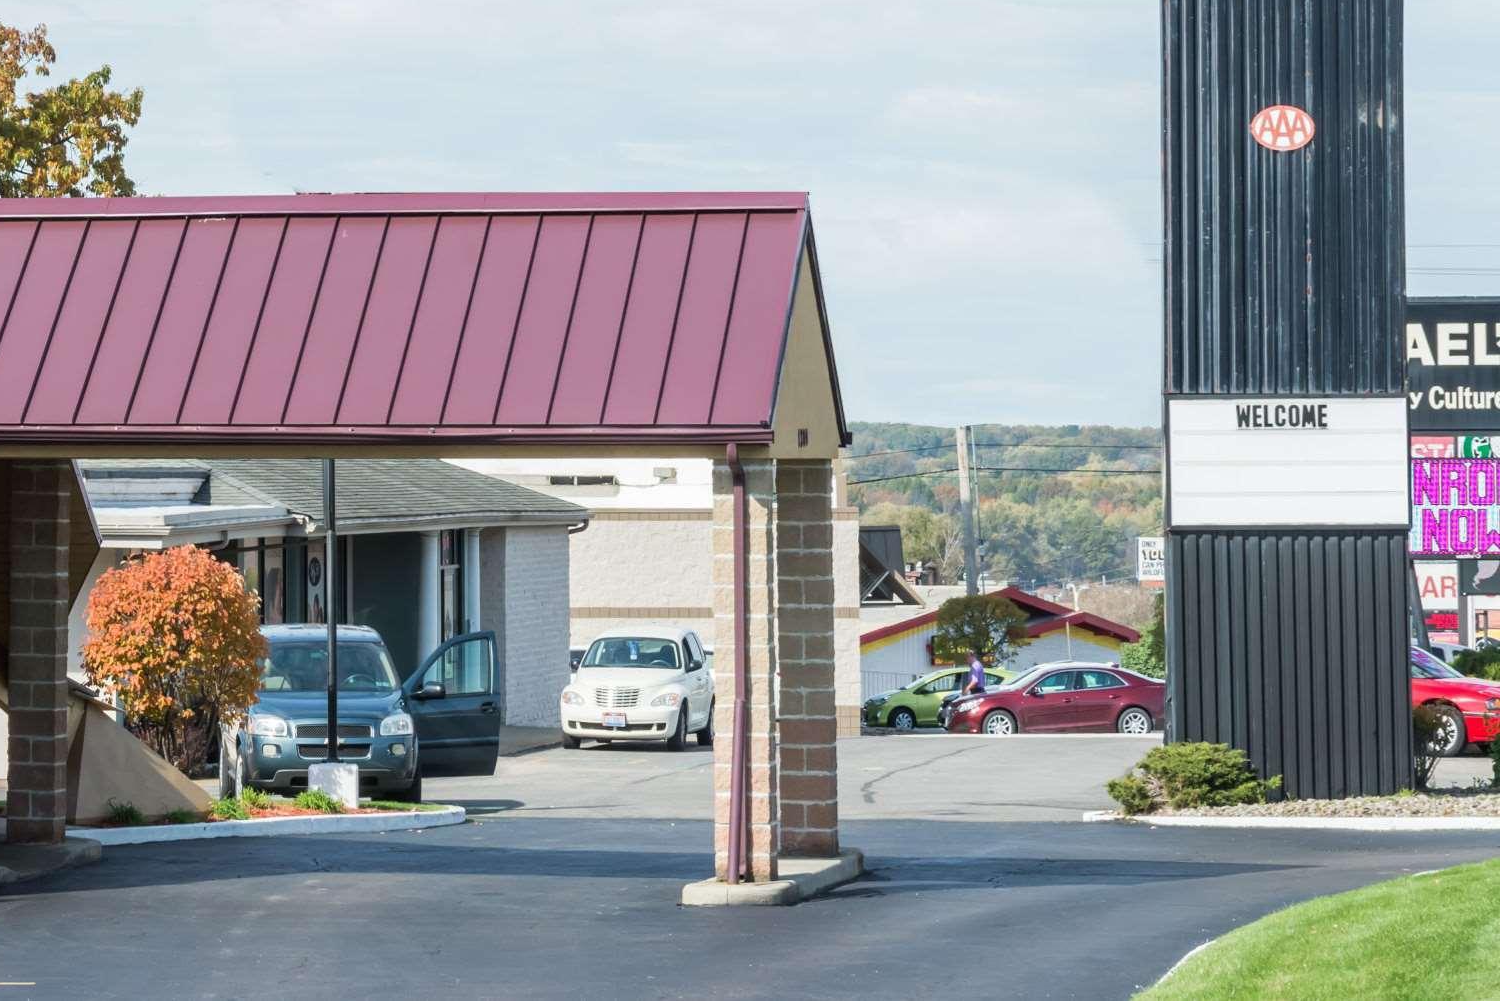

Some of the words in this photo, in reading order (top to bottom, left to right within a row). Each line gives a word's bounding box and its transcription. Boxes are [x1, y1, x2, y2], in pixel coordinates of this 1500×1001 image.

[1257, 107, 1310, 148] AAA
[1236, 404, 1328, 428] WELCOME
[1413, 462, 1500, 505] NRO
[1422, 508, 1500, 552] NOW
